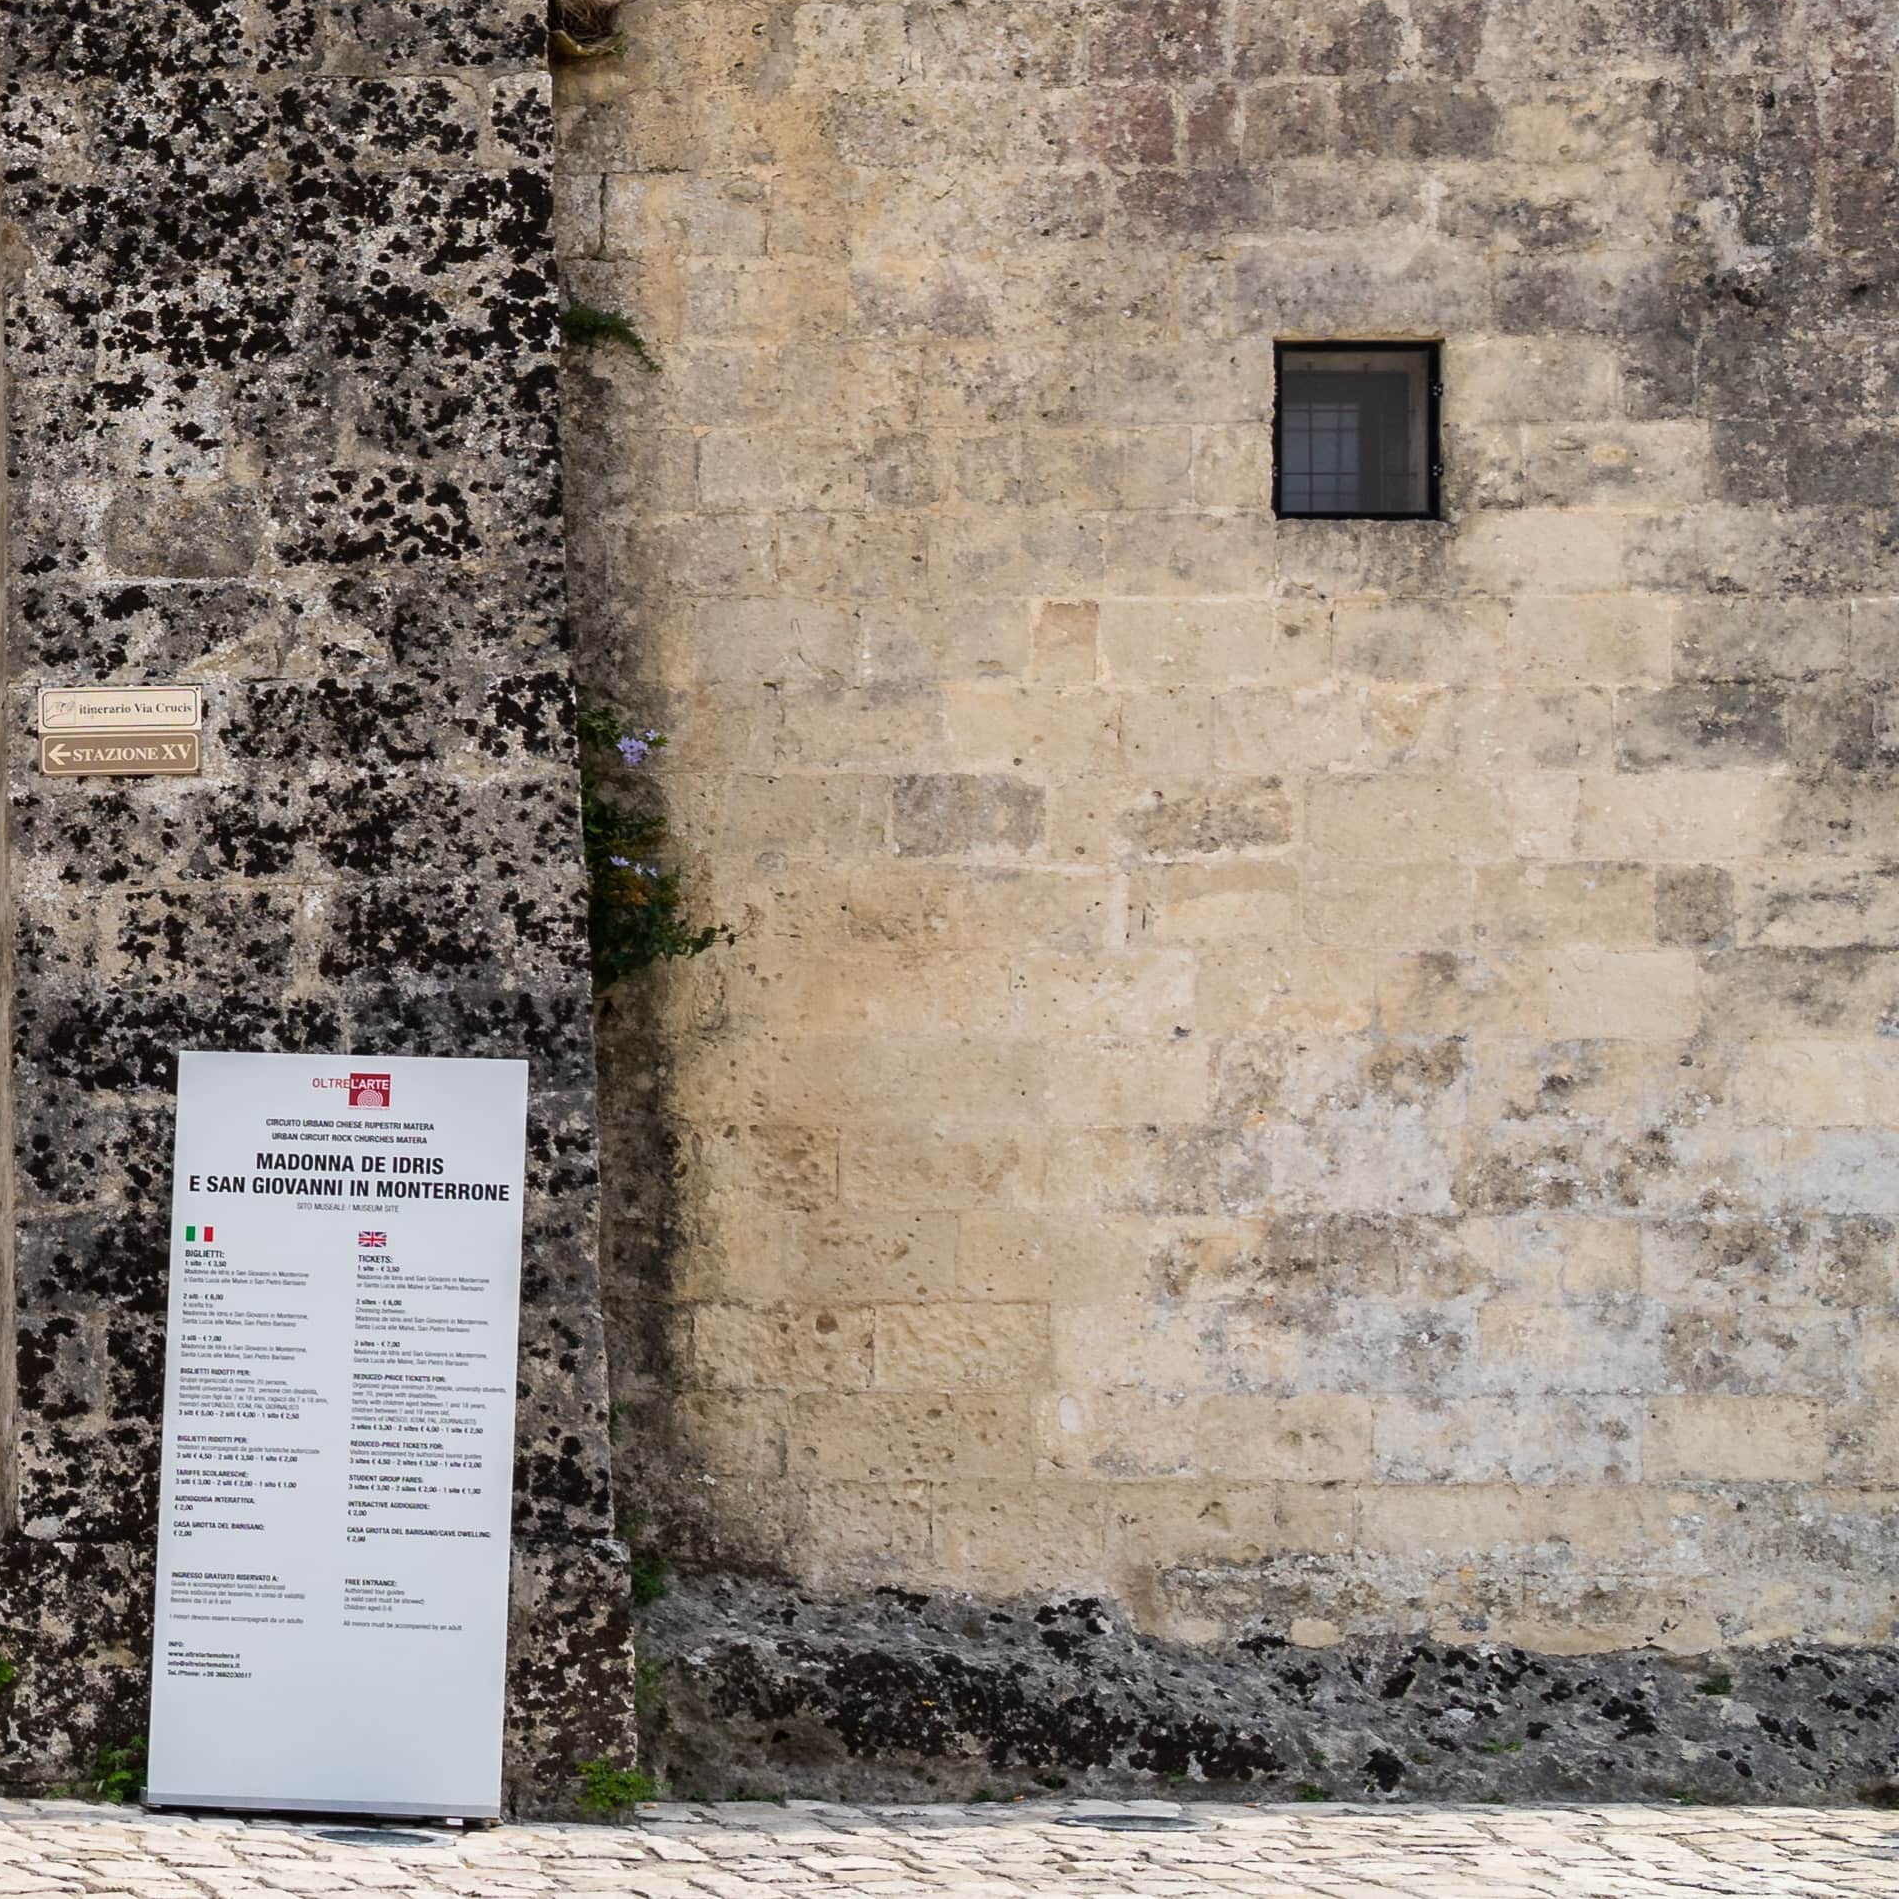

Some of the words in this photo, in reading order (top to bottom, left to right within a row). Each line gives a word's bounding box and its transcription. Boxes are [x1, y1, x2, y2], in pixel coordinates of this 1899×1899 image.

[79, 701, 131, 716] itinerario
[134, 702, 152, 715] Via
[155, 701, 192, 714] Crucis
[72, 746, 159, 763] STAZIONE
[160, 742, 192, 762] XV
[266, 1119, 301, 1127] CIRCUITO
[303, 1120, 334, 1128] URBANO
[336, 1121, 362, 1129] CHIESE
[365, 1121, 401, 1130] RUPESTRI
[403, 1122, 435, 1131] MATERA
[272, 1132, 298, 1141] URBAN
[300, 1133, 330, 1141] CIRCUIT
[332, 1134, 352, 1142] ROCK
[354, 1135, 394, 1143] CHURCHES
[396, 1136, 427, 1144] MATERA
[256, 1153, 355, 1172] MADONNA
[361, 1156, 386, 1173] DE
[393, 1157, 444, 1175] IDRIS
[189, 1175, 200, 1192] E
[207, 1176, 245, 1193] SAN
[252, 1177, 342, 1196] GIOVANNI
[350, 1180, 369, 1197] IN
[376, 1180, 510, 1201] MONTERRONE
[297, 1202, 312, 1210] SITO
[314, 1203, 346, 1211] MUSEALE
[353, 1204, 383, 1212] MUSEUM
[385, 1205, 399, 1213] SITE
[185, 1249, 226, 1258] BIGLIETTI:
[358, 1254, 393, 1264] TICKETS:
